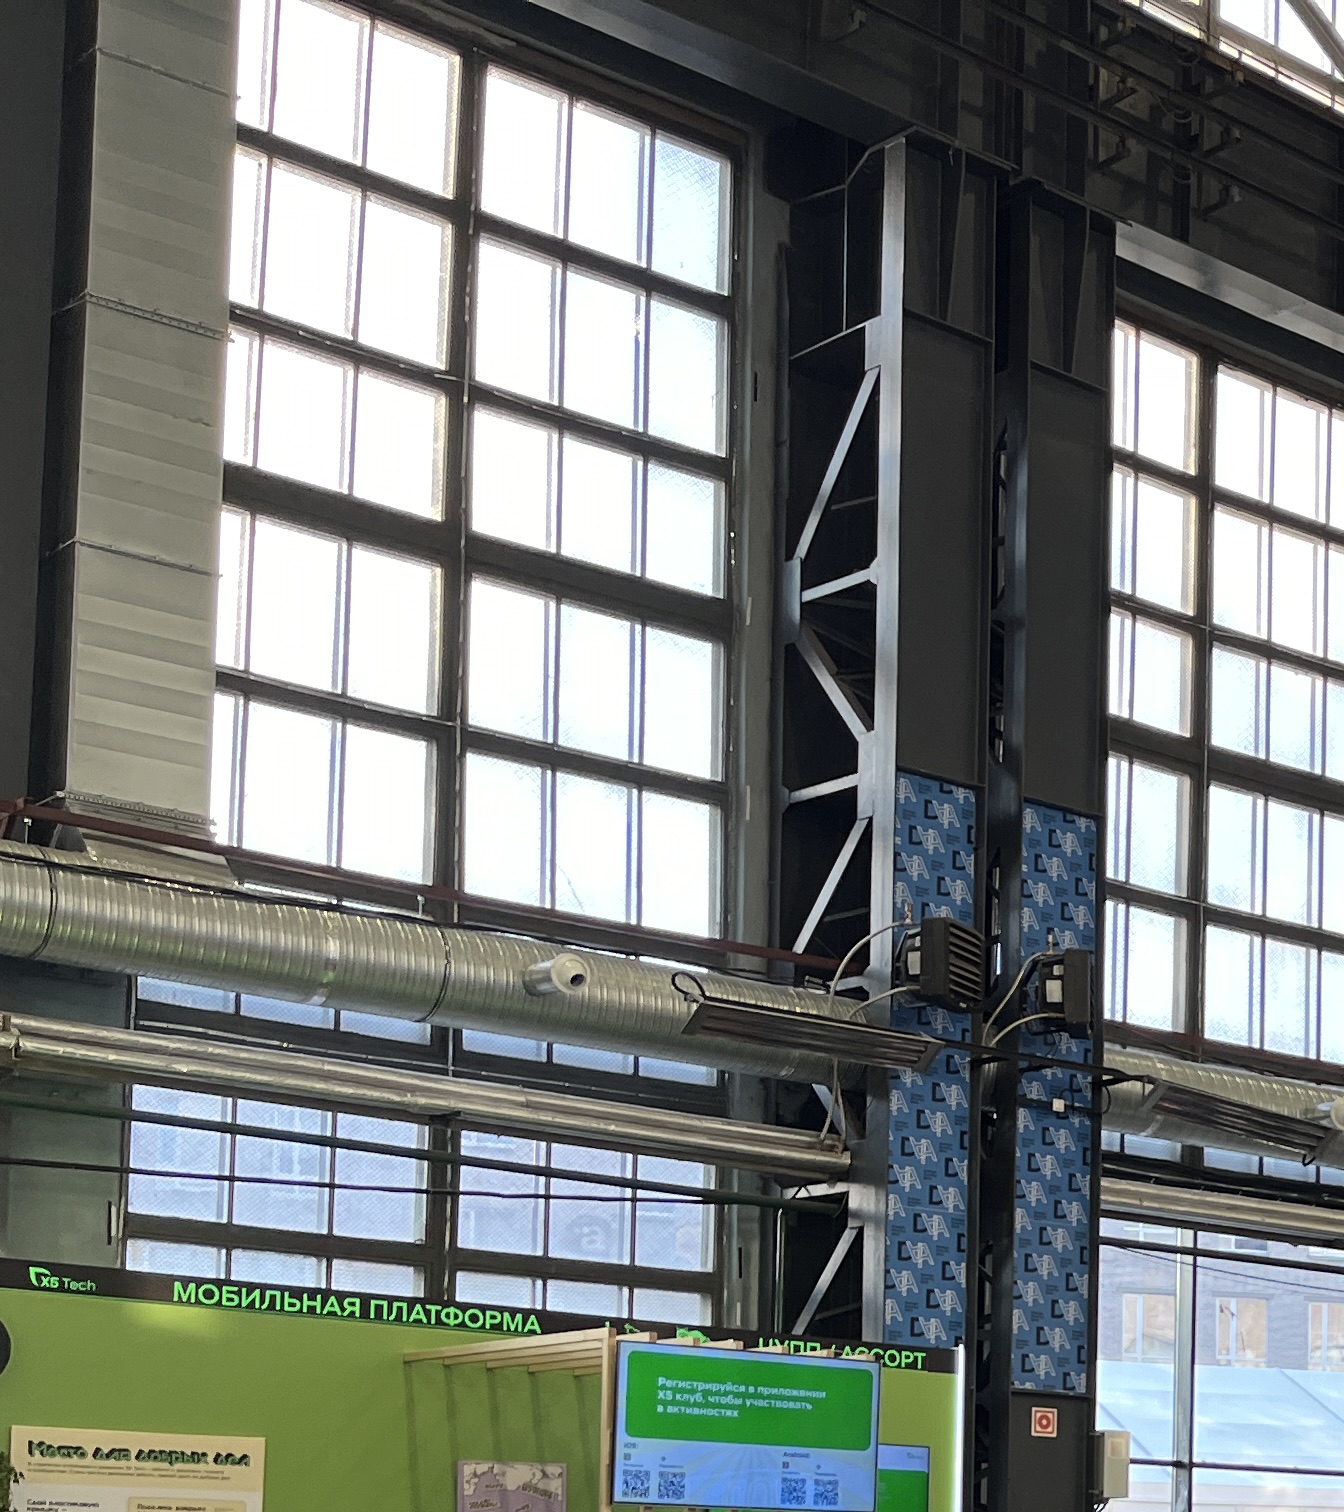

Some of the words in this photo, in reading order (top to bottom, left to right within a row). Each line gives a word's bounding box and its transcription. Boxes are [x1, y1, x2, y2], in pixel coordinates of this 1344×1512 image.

[173, 1281, 360, 1318] МОБИЛЬНАЯ
[370, 1300, 542, 1334] ПЛАТФОРМА
[657, 1377, 745, 1394] Регистрируйся
